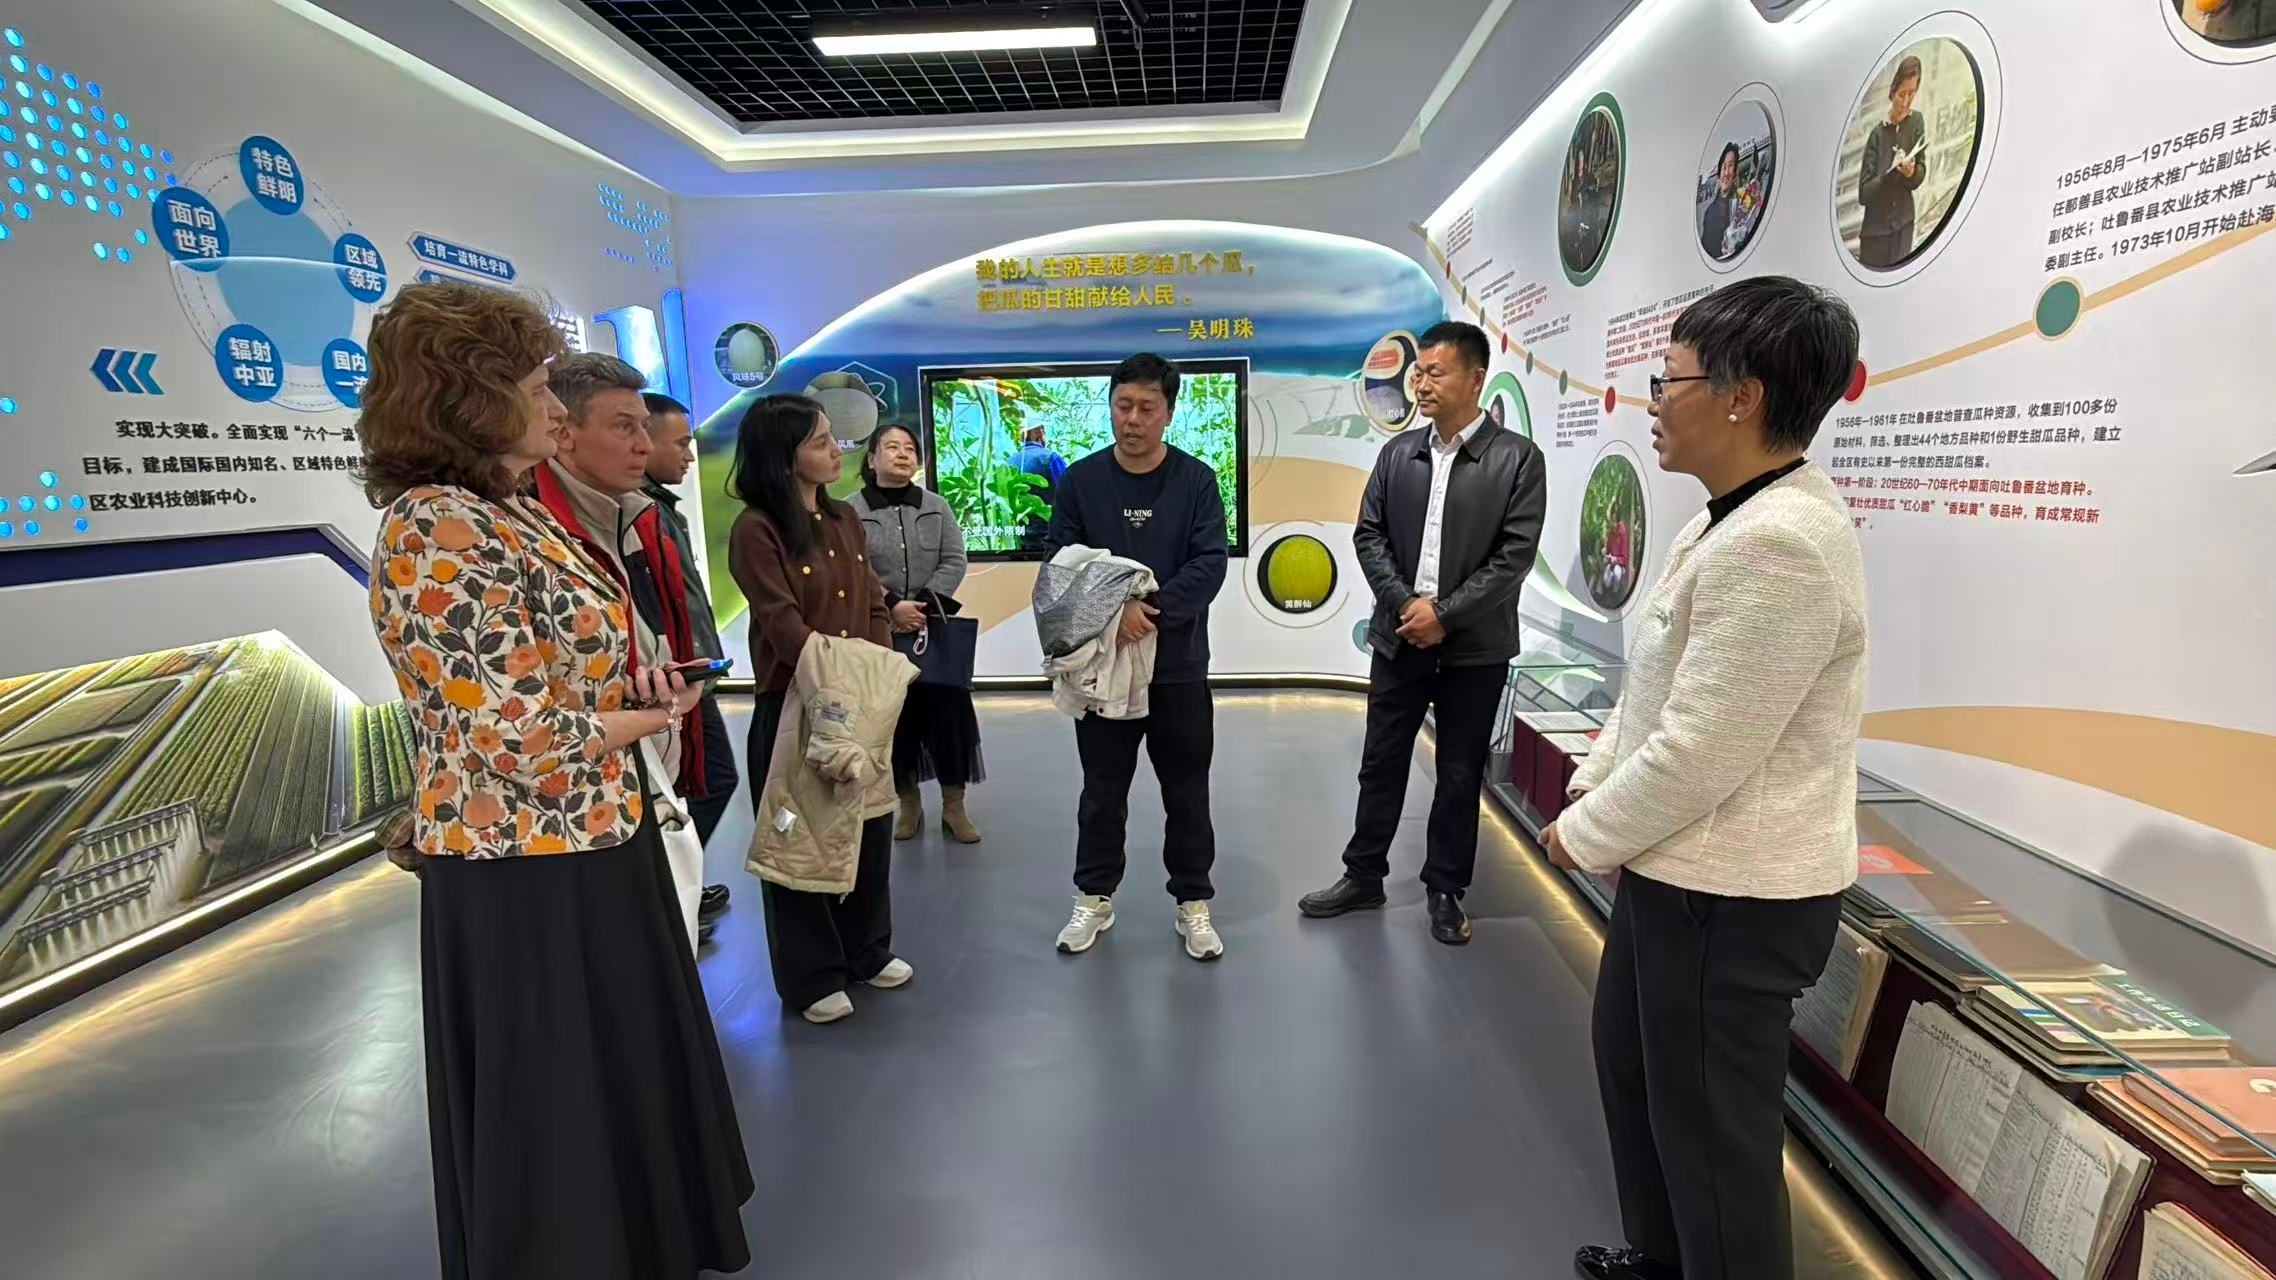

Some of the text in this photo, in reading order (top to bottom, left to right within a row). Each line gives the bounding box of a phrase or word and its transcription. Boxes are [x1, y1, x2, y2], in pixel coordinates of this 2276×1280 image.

[251, 147, 294, 178] 特色
[257, 173, 297, 204] 鲜明
[167, 199, 217, 231] 面向
[173, 229, 222, 258] 世界
[345, 244, 378, 268] 区域
[424, 239, 509, 276] 培育一流特色学科
[347, 268, 382, 292] 领先
[977, 284, 1193, 312] 把瓜的甘甜献给人民。
[228, 337, 272, 362] 辐射
[332, 350, 367, 372] 国内
[233, 364, 277, 387] 中亚
[89, 488, 257, 511] 区农业科技创新中心。
[1124, 508, 1153, 518] LI-NING
